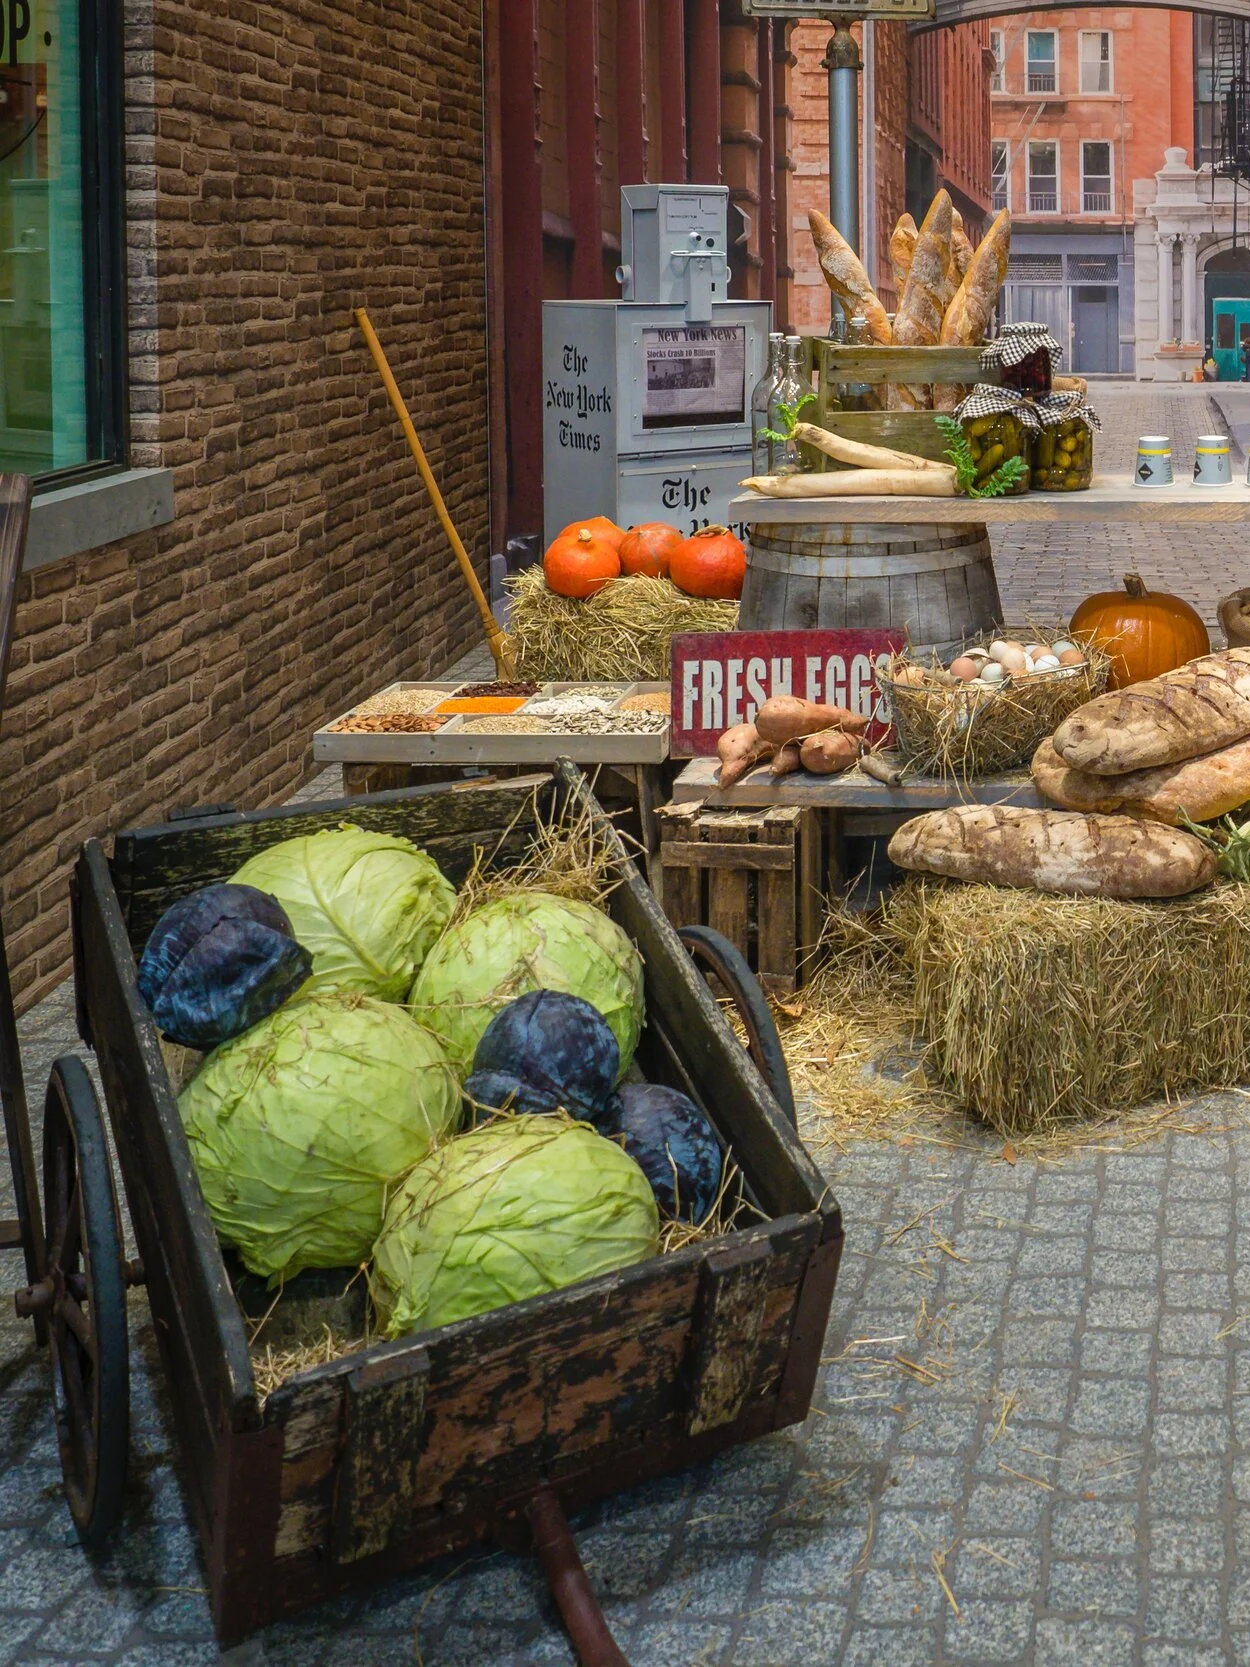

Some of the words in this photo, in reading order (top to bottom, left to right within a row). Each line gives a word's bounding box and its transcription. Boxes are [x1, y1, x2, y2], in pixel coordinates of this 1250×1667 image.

[658, 328, 680, 342] New
[682, 327, 708, 341] York
[710, 327, 737, 341] News
[563, 344, 588, 377] The
[646, 350, 666, 359] Stocks
[667, 349, 684, 358] Crash
[546, 380, 575, 409] New
[577, 384, 612, 420] York
[559, 420, 601, 453] Times
[662, 477, 711, 512] The
[682, 656, 793, 731] FRESH
